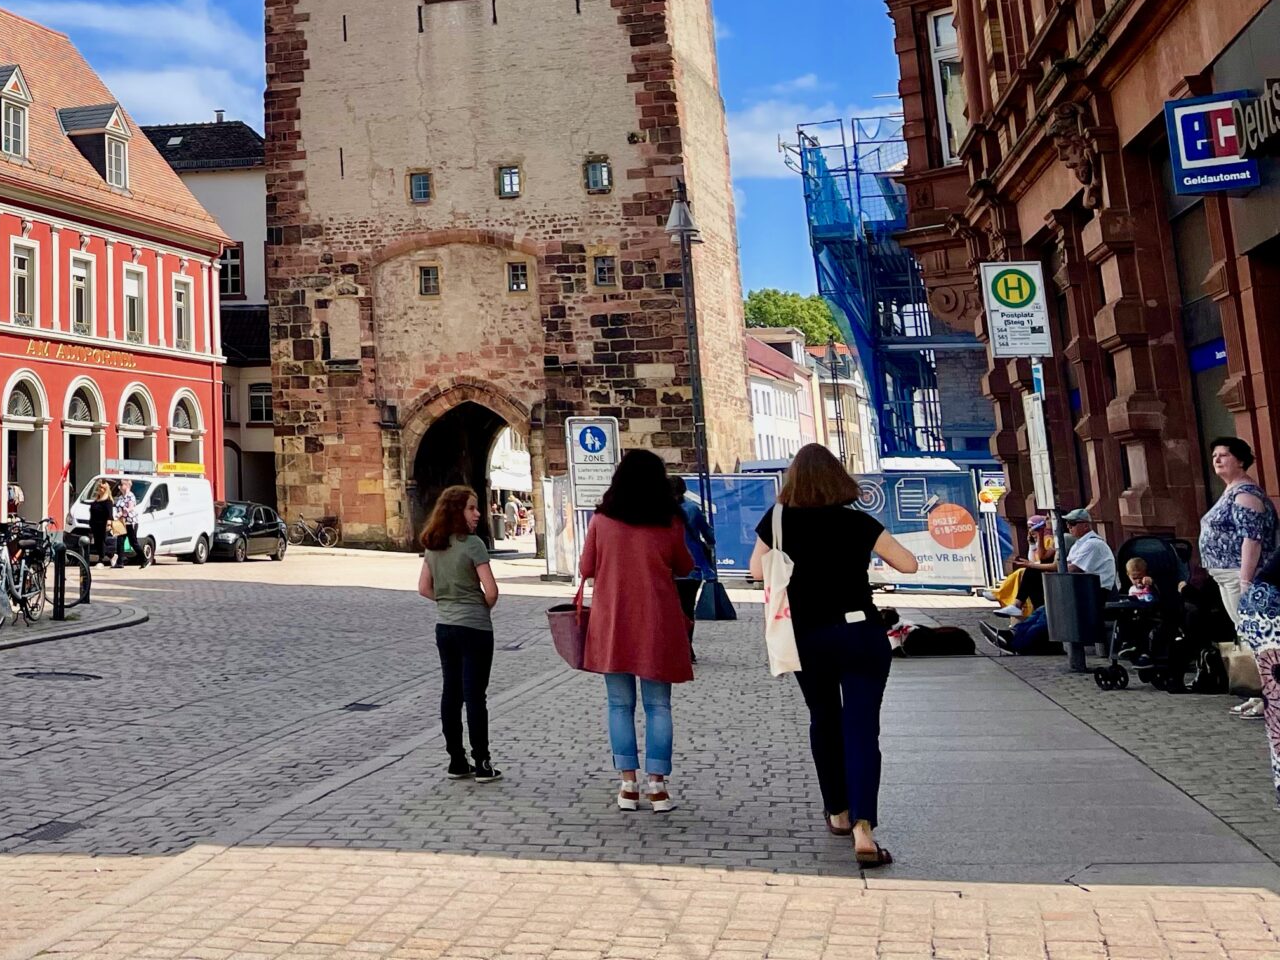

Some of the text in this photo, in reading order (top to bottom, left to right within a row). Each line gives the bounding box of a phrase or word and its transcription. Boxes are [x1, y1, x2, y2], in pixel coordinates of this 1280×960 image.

[1183, 170, 1251, 186] Geldautomat
[1003, 277, 1024, 300] H
[583, 454, 605, 462] ZONE
[935, 553, 950, 562] VR
[952, 553, 977, 562] Bank
